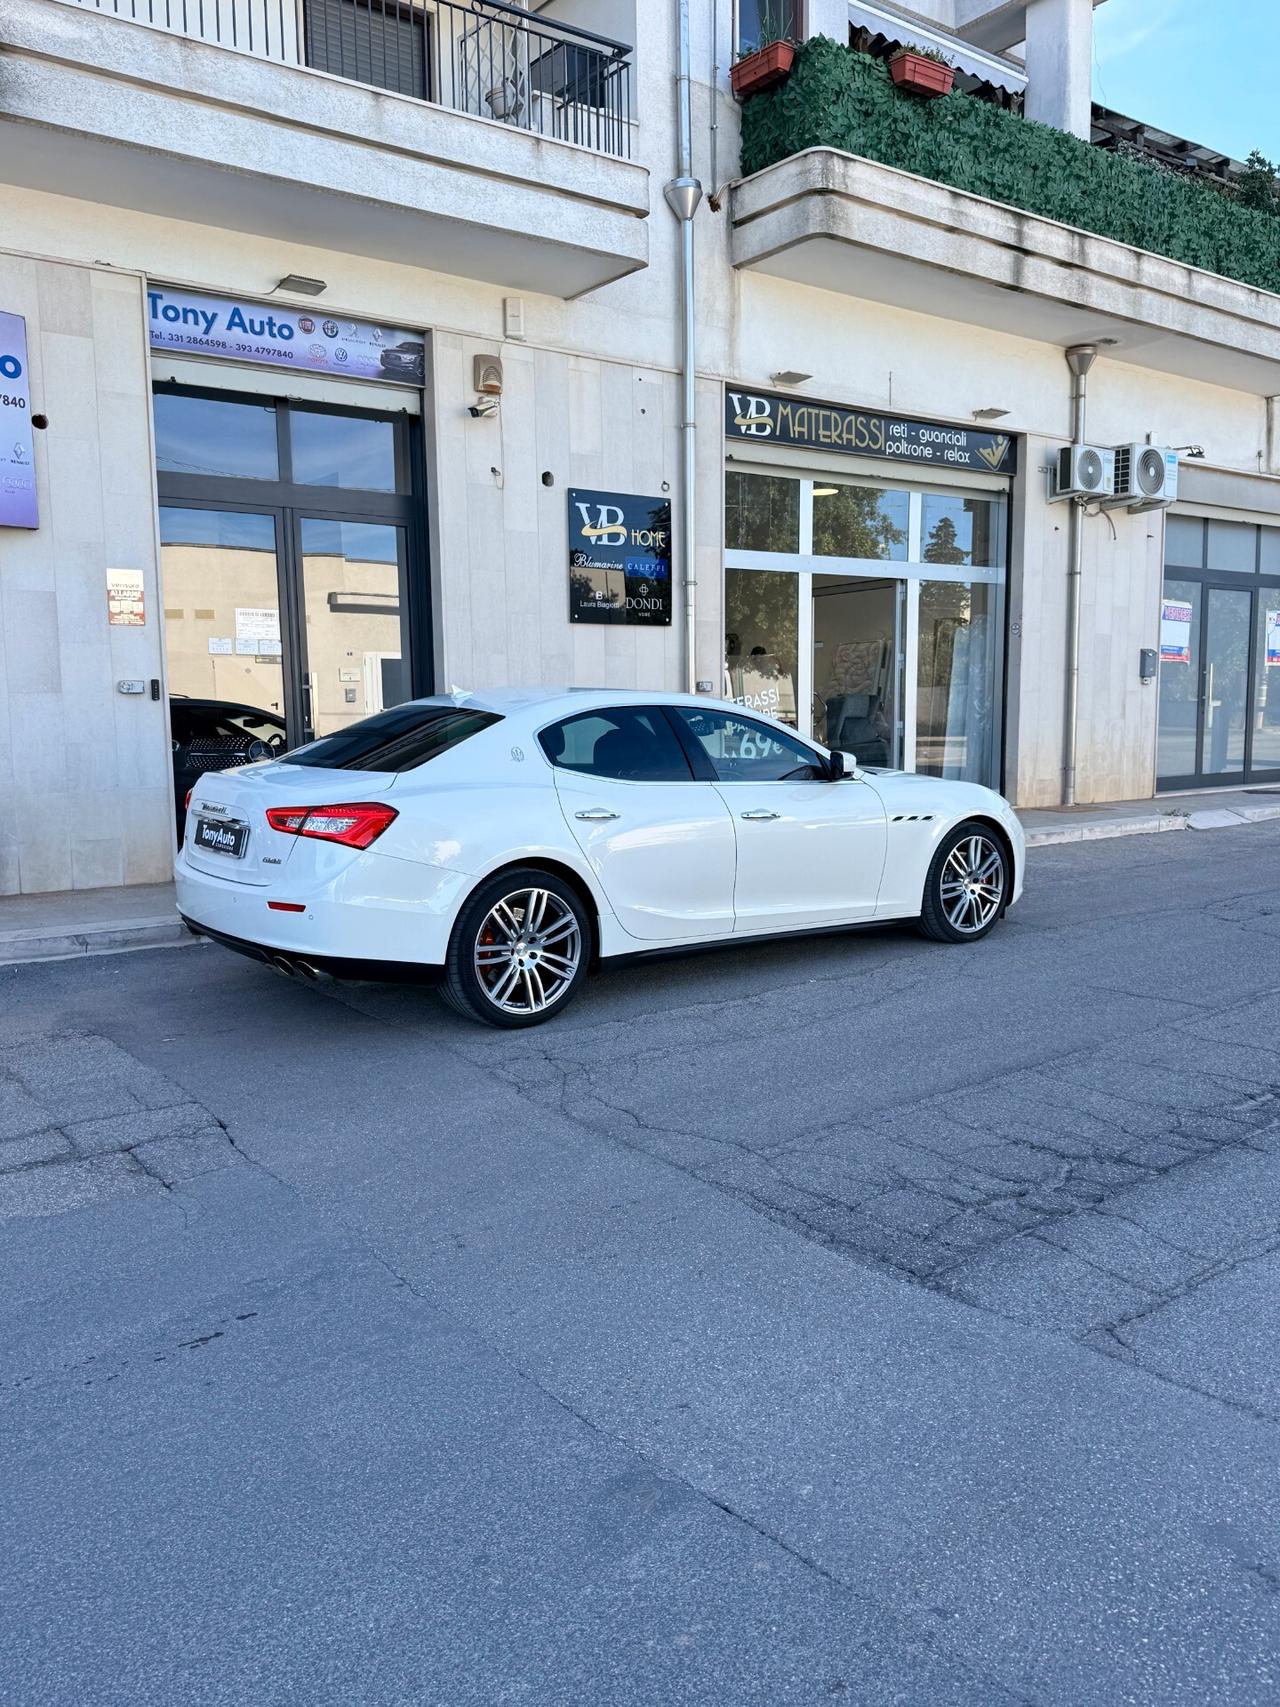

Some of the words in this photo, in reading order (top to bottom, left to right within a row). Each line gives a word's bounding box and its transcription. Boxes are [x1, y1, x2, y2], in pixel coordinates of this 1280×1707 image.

[147, 291, 218, 335] Tony
[226, 306, 294, 341] Auto
[150, 330, 166, 340] Tel.
[168, 333, 184, 342] 331
[186, 336, 227, 349] 2864598
[235, 344, 252, 353] 393
[254, 346, 294, 359] 4797840
[0, 394, 26, 409] 840
[776, 402, 885, 451] MATERASSI
[889, 423, 908, 438] reti
[919, 429, 967, 446] guanciali
[886, 440, 933, 458] poltrone
[944, 447, 970, 463] relax
[631, 529, 666, 547] HOME
[573, 553, 624, 570] Blumarine
[627, 562, 665, 572] CALEFFI
[580, 600, 596, 608] Laura
[626, 597, 663, 610] DONDI
